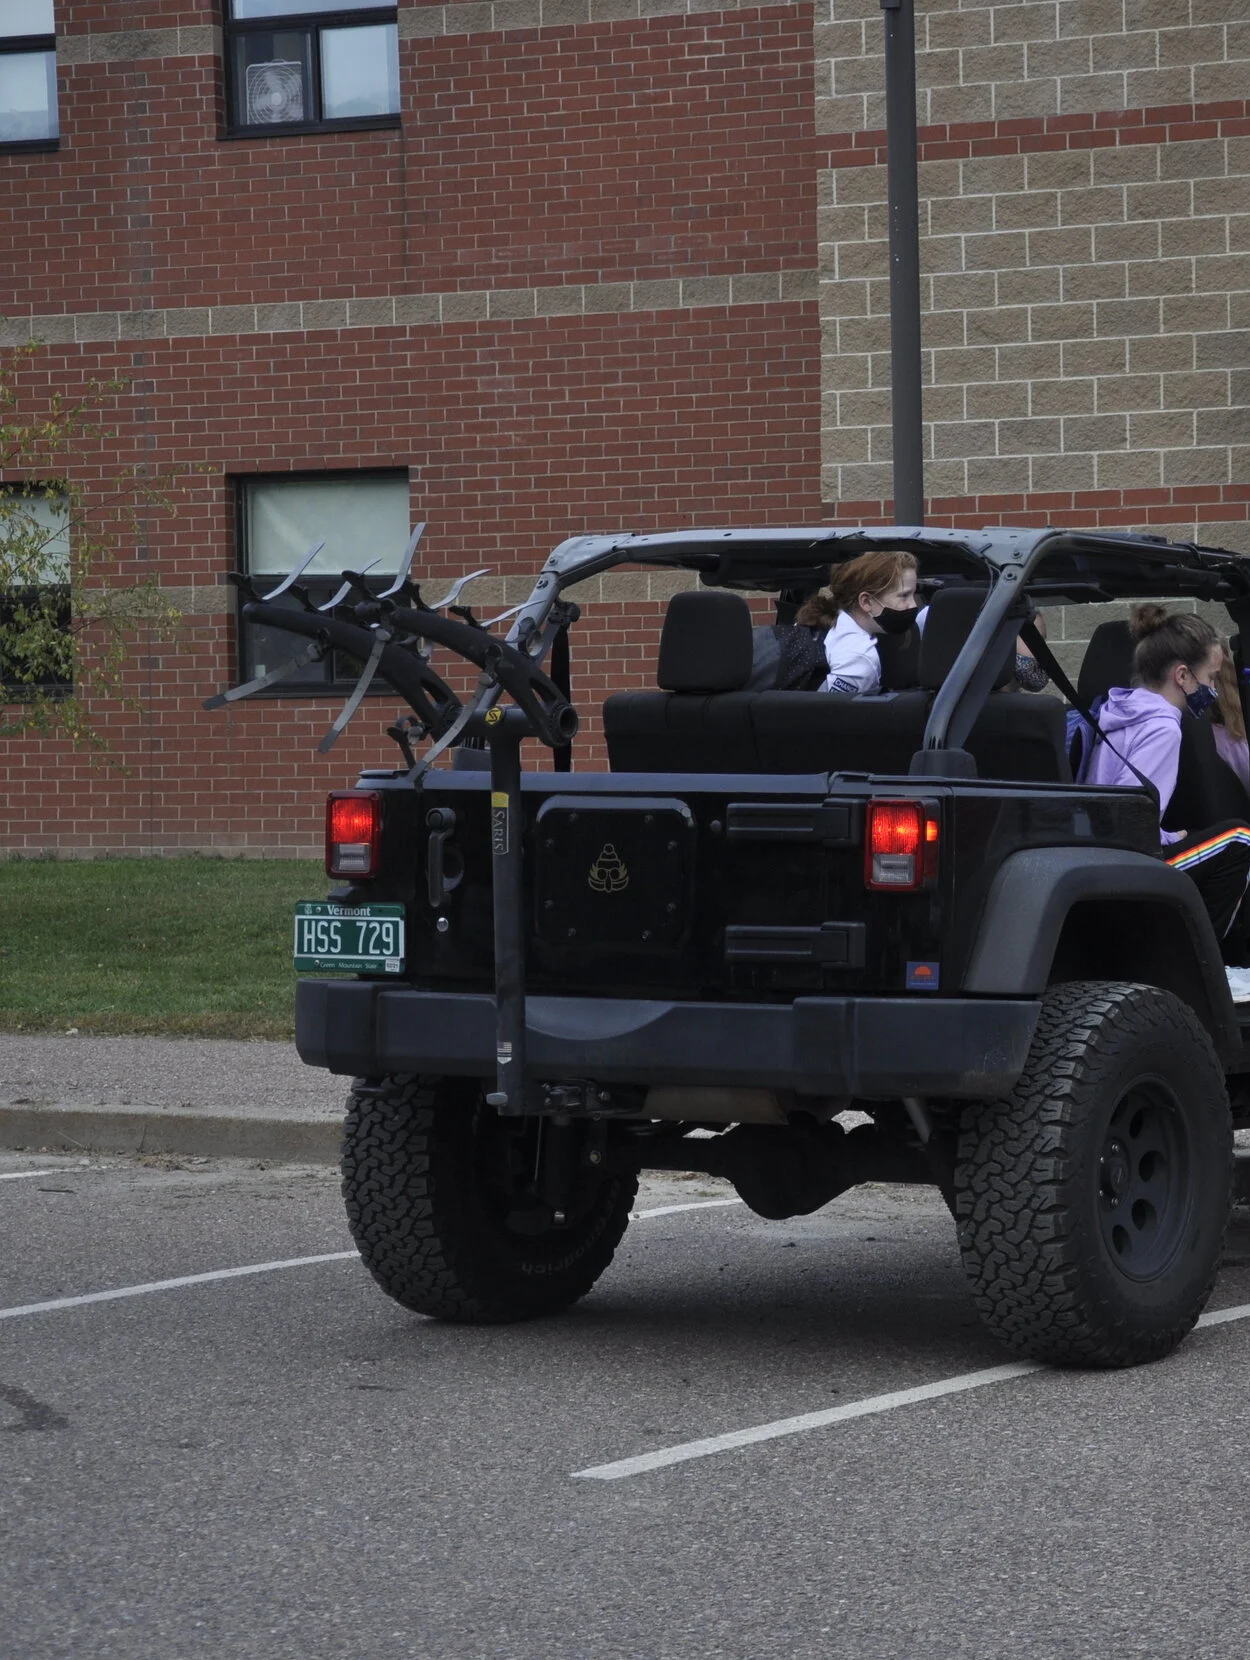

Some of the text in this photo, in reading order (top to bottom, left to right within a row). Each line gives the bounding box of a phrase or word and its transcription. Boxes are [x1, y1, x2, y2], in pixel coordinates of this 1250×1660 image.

[493, 810, 505, 851] SARIS
[327, 905, 371, 917] Vermont
[303, 920, 394, 955] HSS 729
